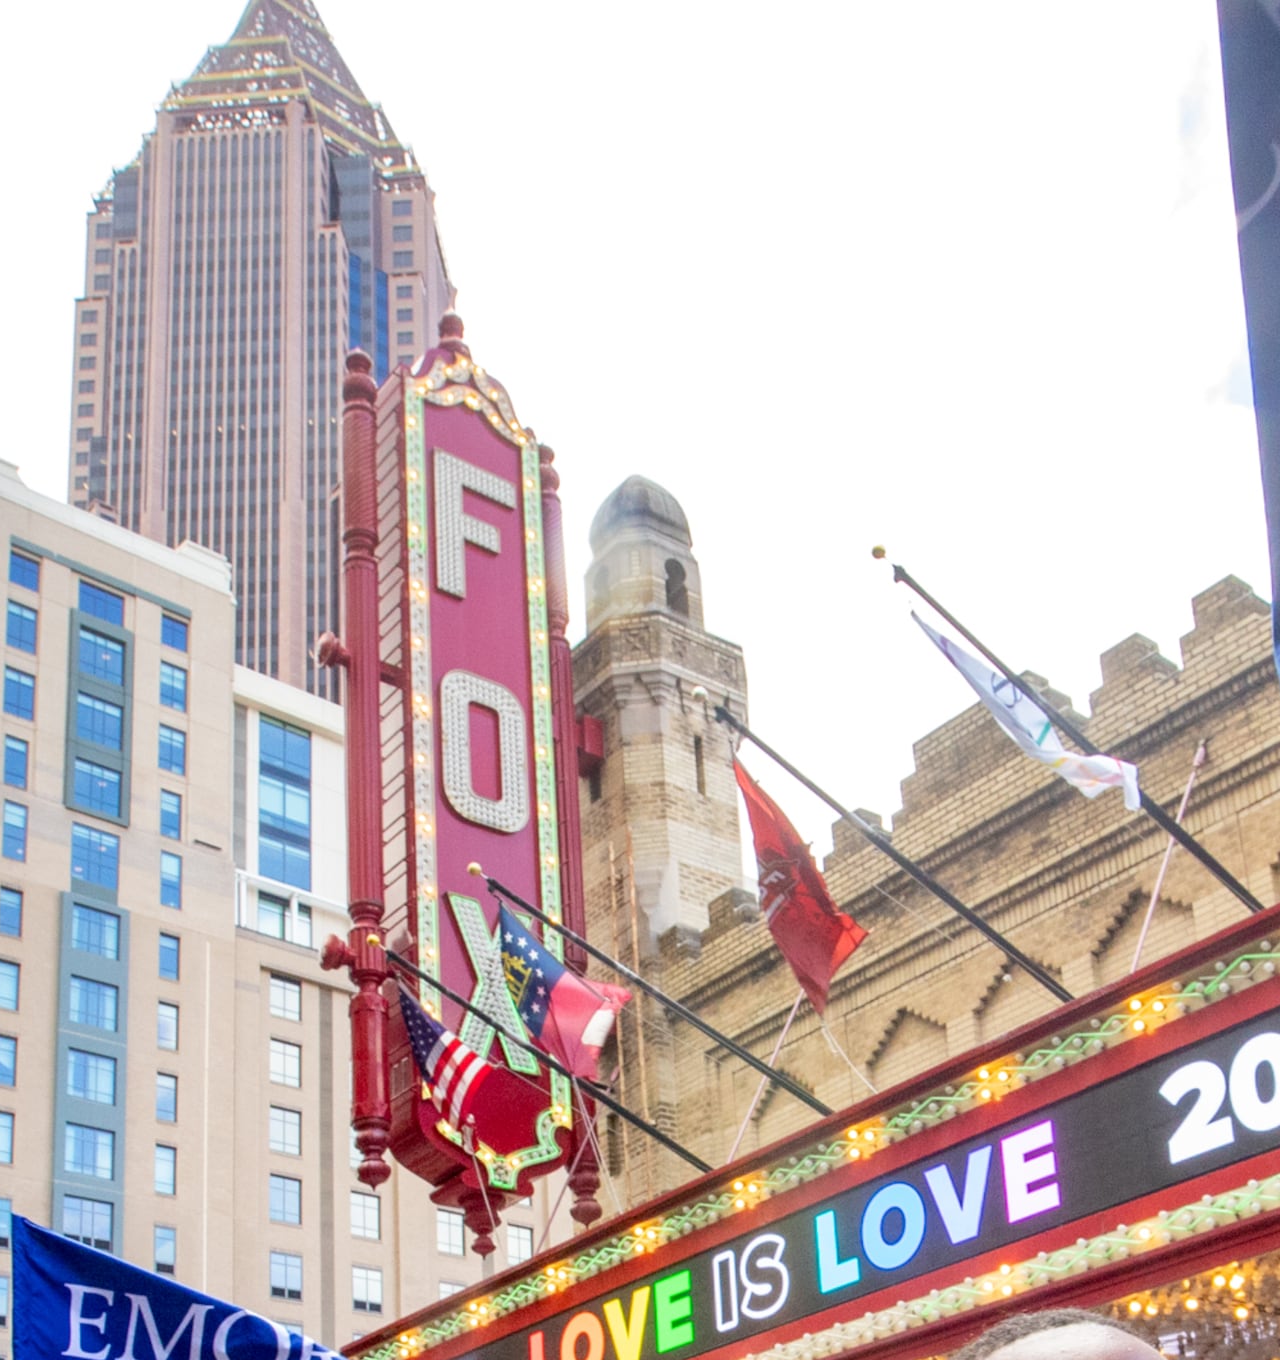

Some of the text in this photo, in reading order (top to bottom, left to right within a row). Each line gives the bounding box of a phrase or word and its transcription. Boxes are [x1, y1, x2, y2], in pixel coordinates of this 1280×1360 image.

[433, 447, 543, 1077] FOX
[712, 1233, 791, 1334] IS
[814, 1119, 1063, 1295] LOVE
